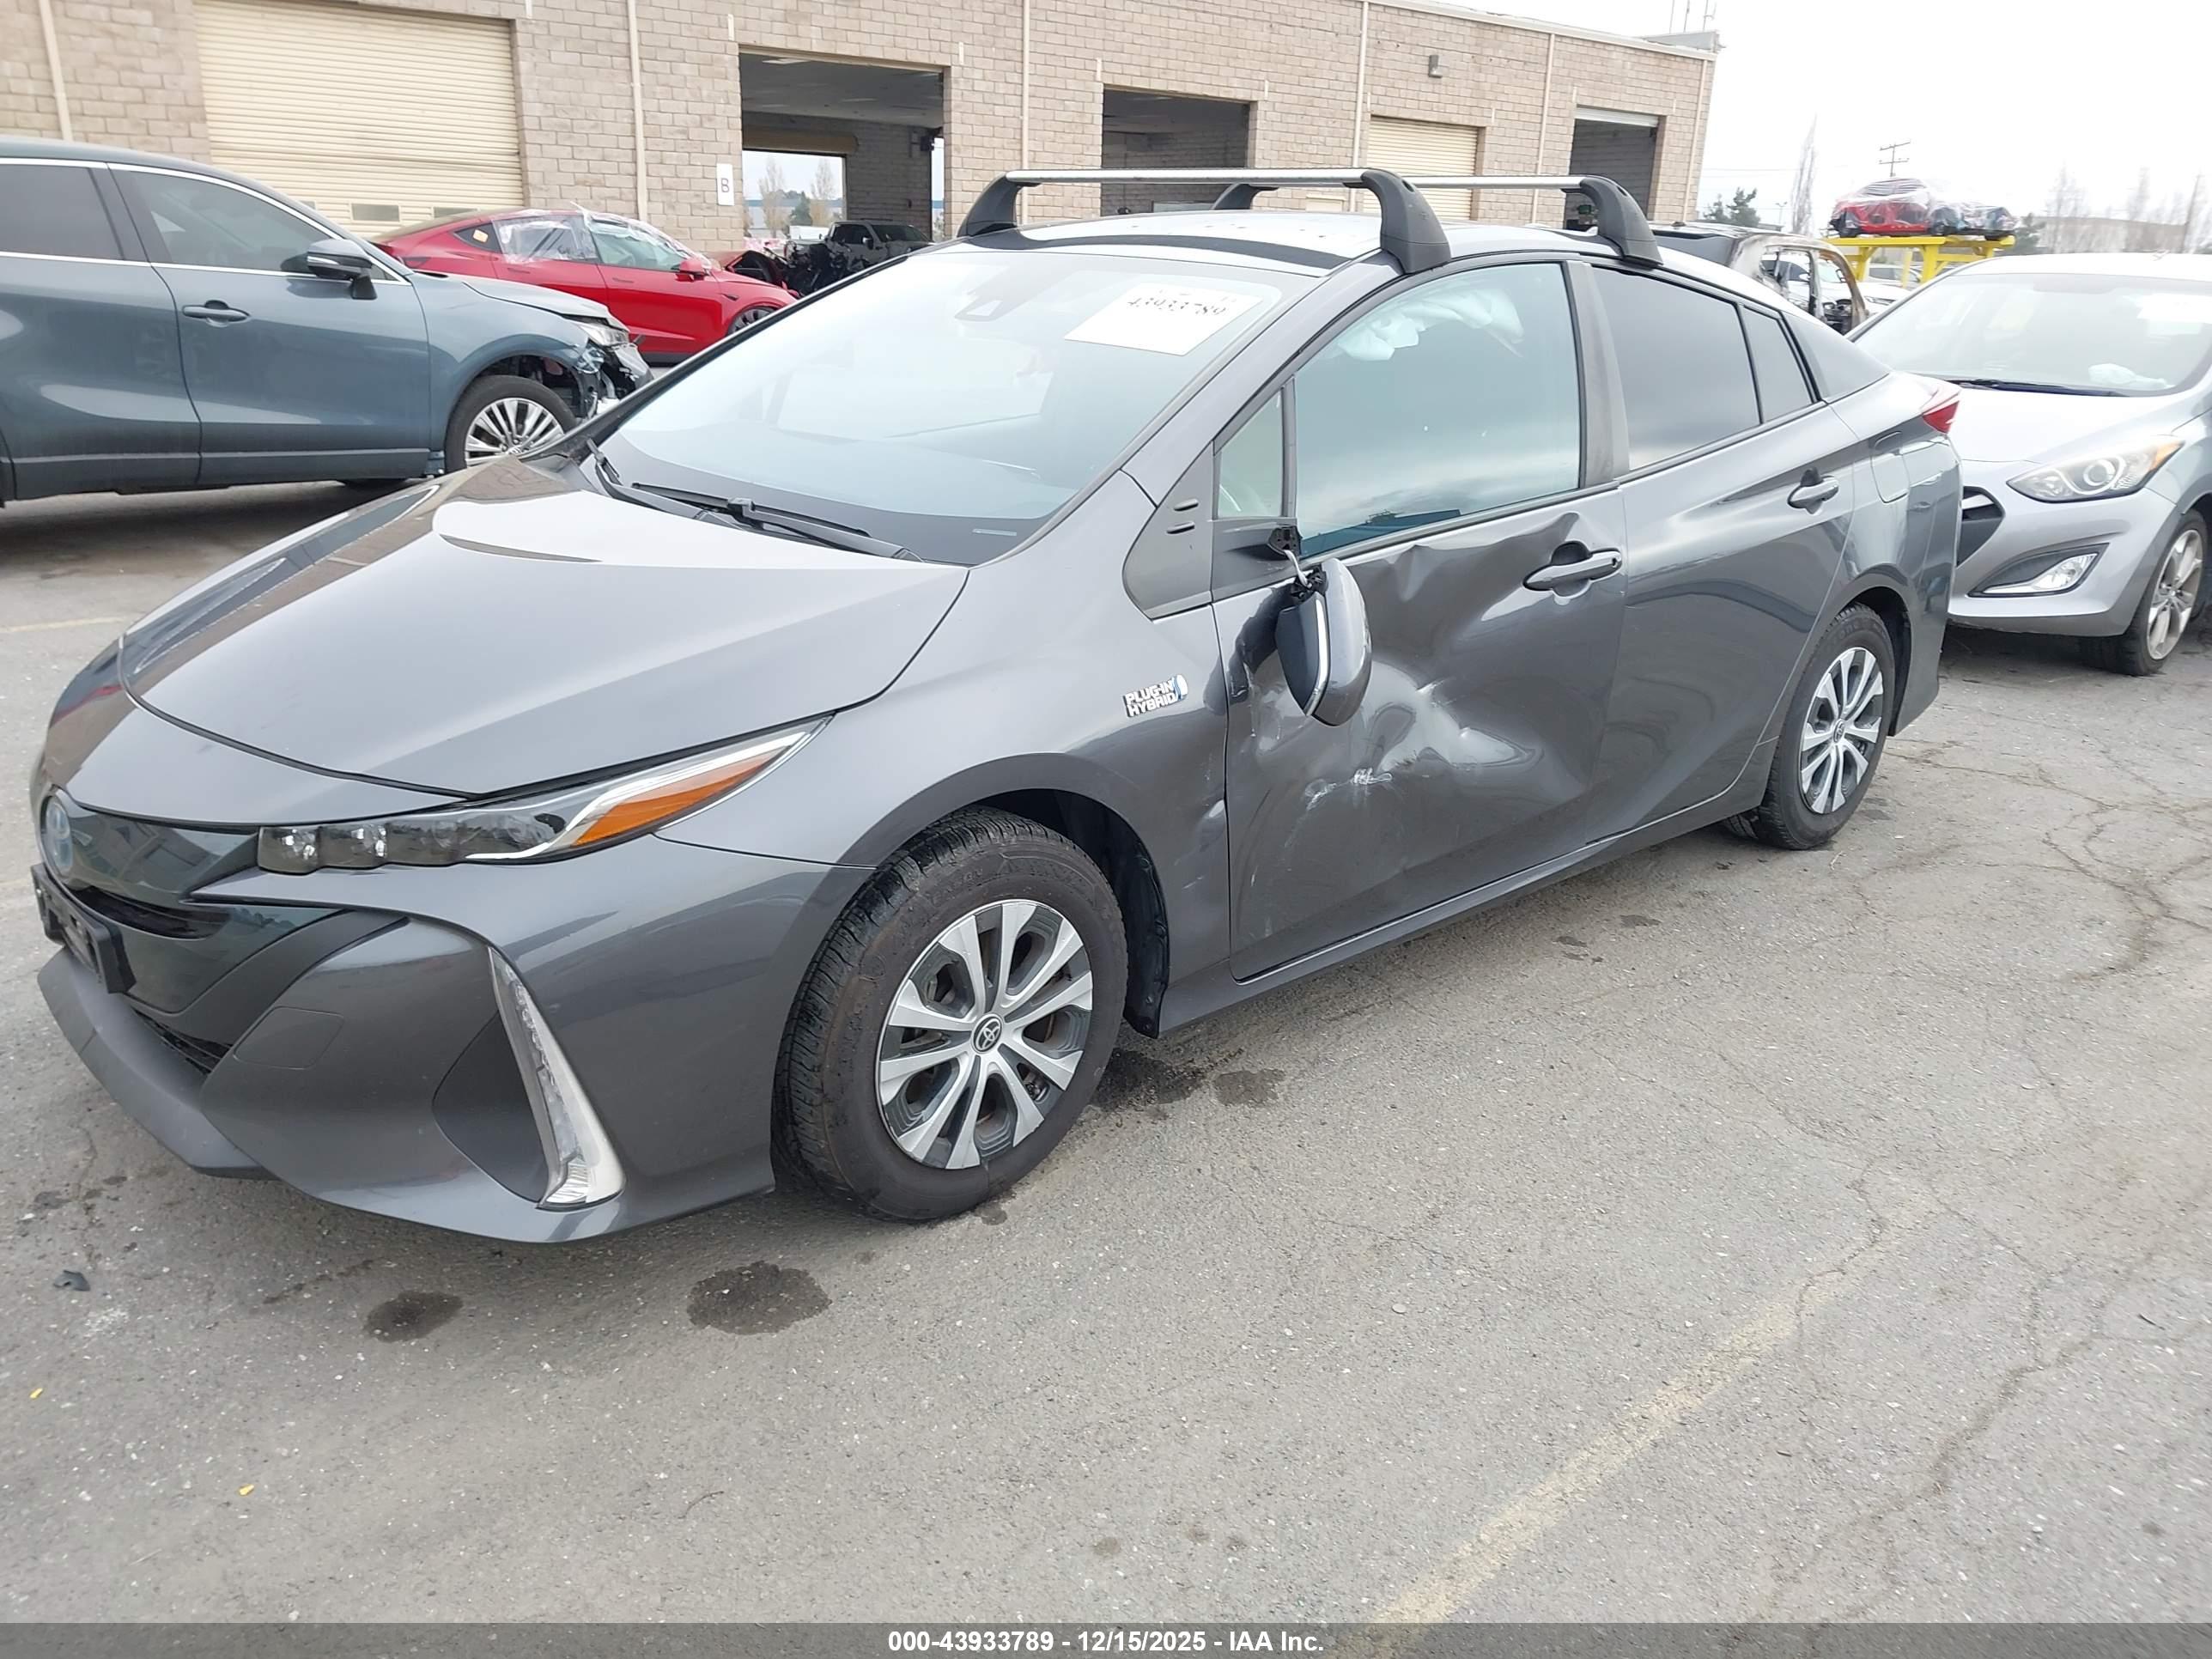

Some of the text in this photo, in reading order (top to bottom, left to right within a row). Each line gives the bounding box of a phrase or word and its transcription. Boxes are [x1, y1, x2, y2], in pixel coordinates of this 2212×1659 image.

[720, 178, 730, 193] B
[1124, 678, 1174, 705] PLUG-IN
[1127, 692, 1178, 717] HYBRID
